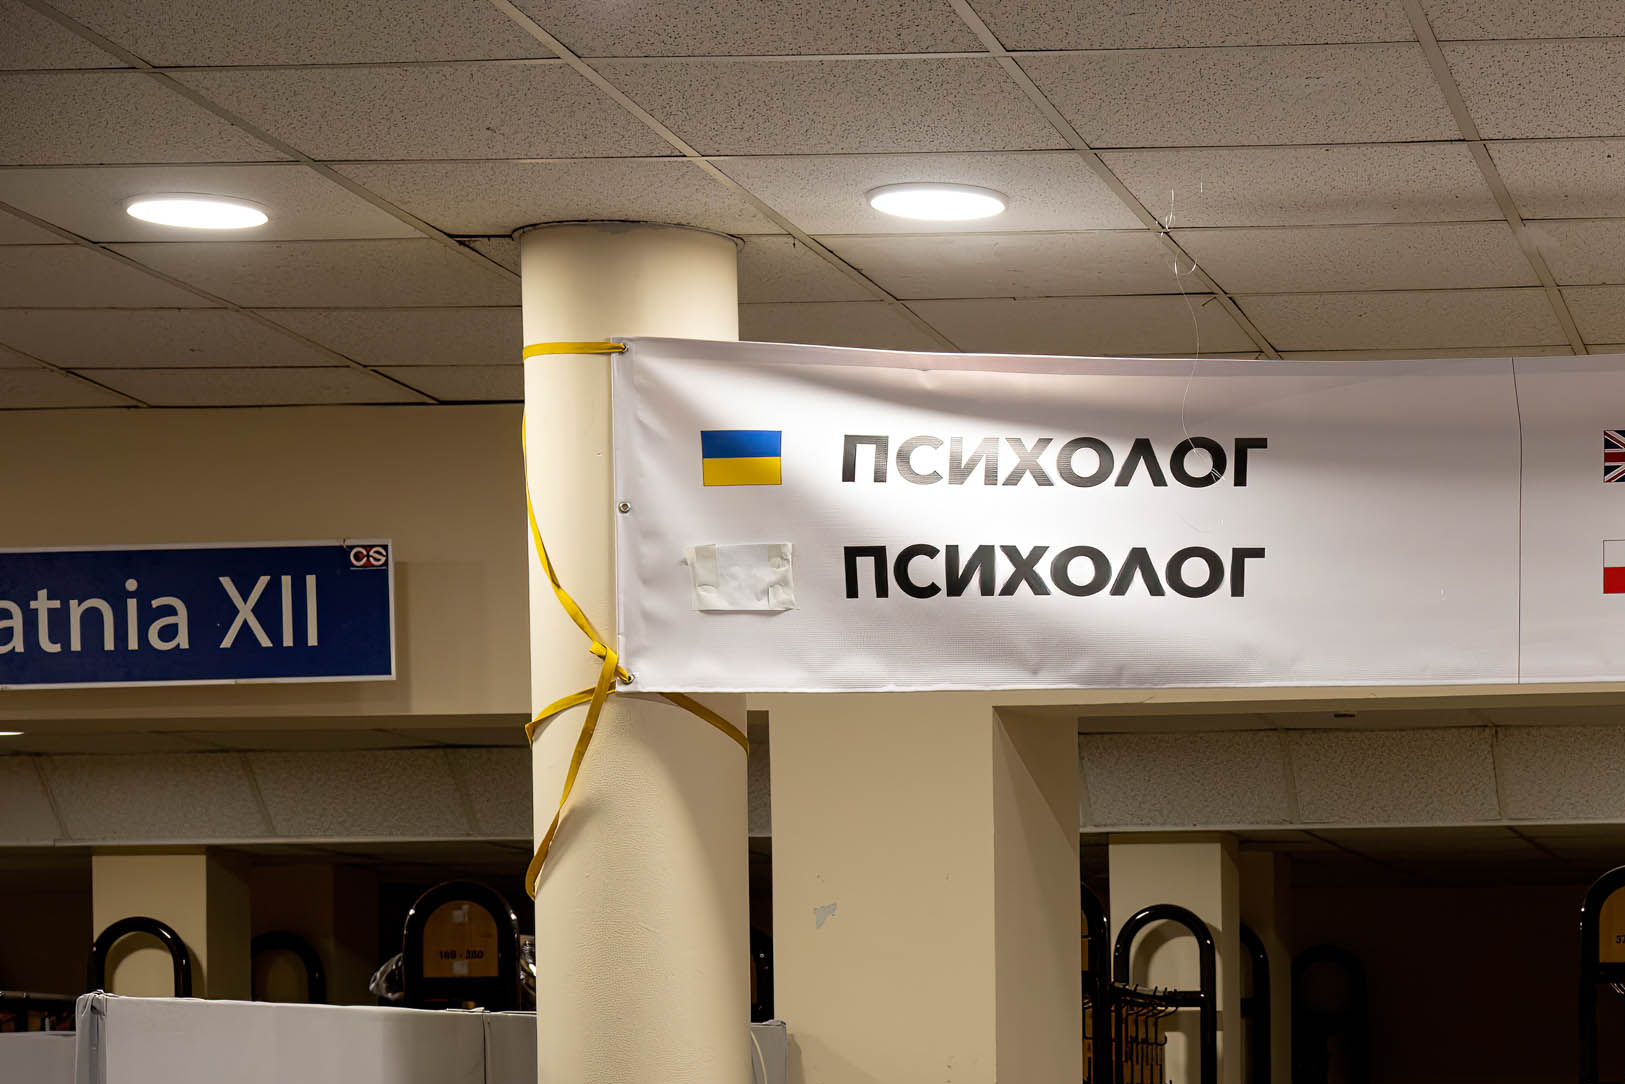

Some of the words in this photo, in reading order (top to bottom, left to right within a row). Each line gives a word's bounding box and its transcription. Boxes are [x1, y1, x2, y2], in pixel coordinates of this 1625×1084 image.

[842, 433, 1267, 488] ПСИХОЛОГ
[843, 544, 1265, 599] ПСИХОЛОГ
[218, 574, 319, 649] XII
